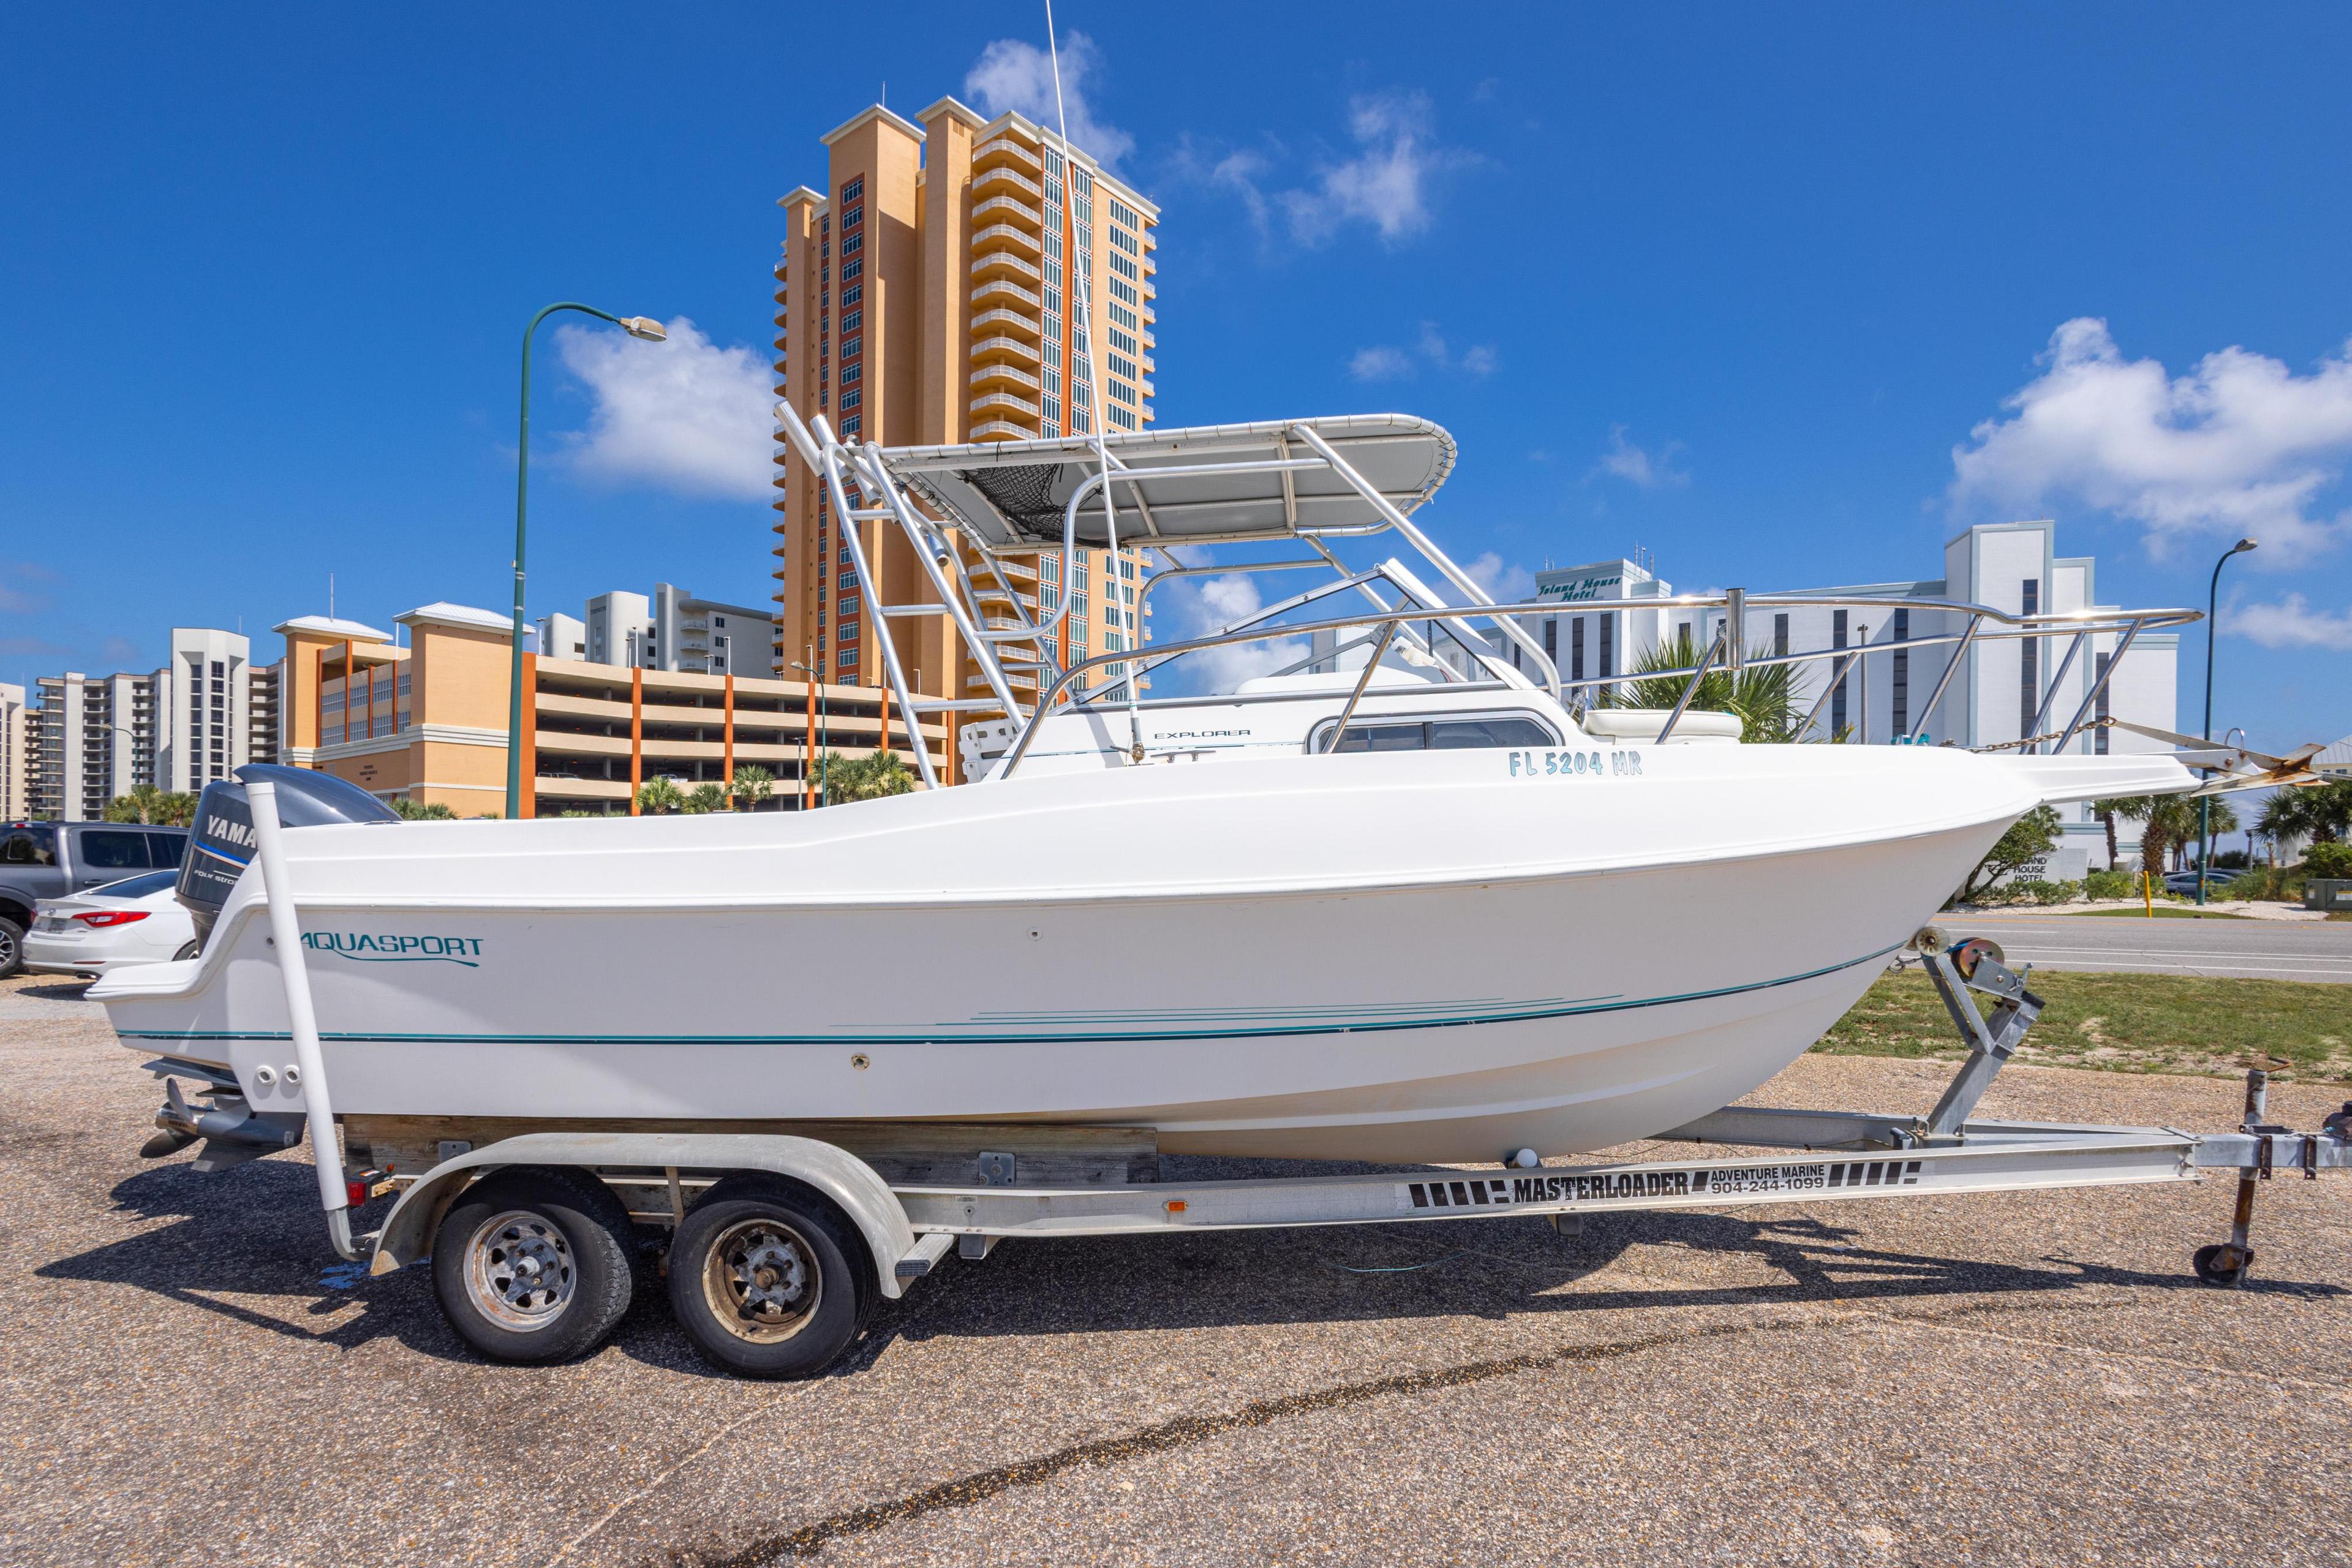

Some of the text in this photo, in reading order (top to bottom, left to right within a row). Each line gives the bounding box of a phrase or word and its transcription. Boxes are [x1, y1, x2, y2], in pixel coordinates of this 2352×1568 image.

[1538, 577, 1621, 596] Island House
[1561, 588, 1597, 601] Hotel
[1155, 729, 1251, 739] EXPLORER
[1509, 751, 1642, 777] FL 5204 MR
[207, 815, 257, 849] YAMA
[300, 932, 484, 957] AQUASPORT
[1711, 1164, 1825, 1182] ADVENTURE MARINE
[1514, 1172, 1689, 1203] MASTERLOADER
[1711, 1177, 1824, 1194] 904-244-1099
